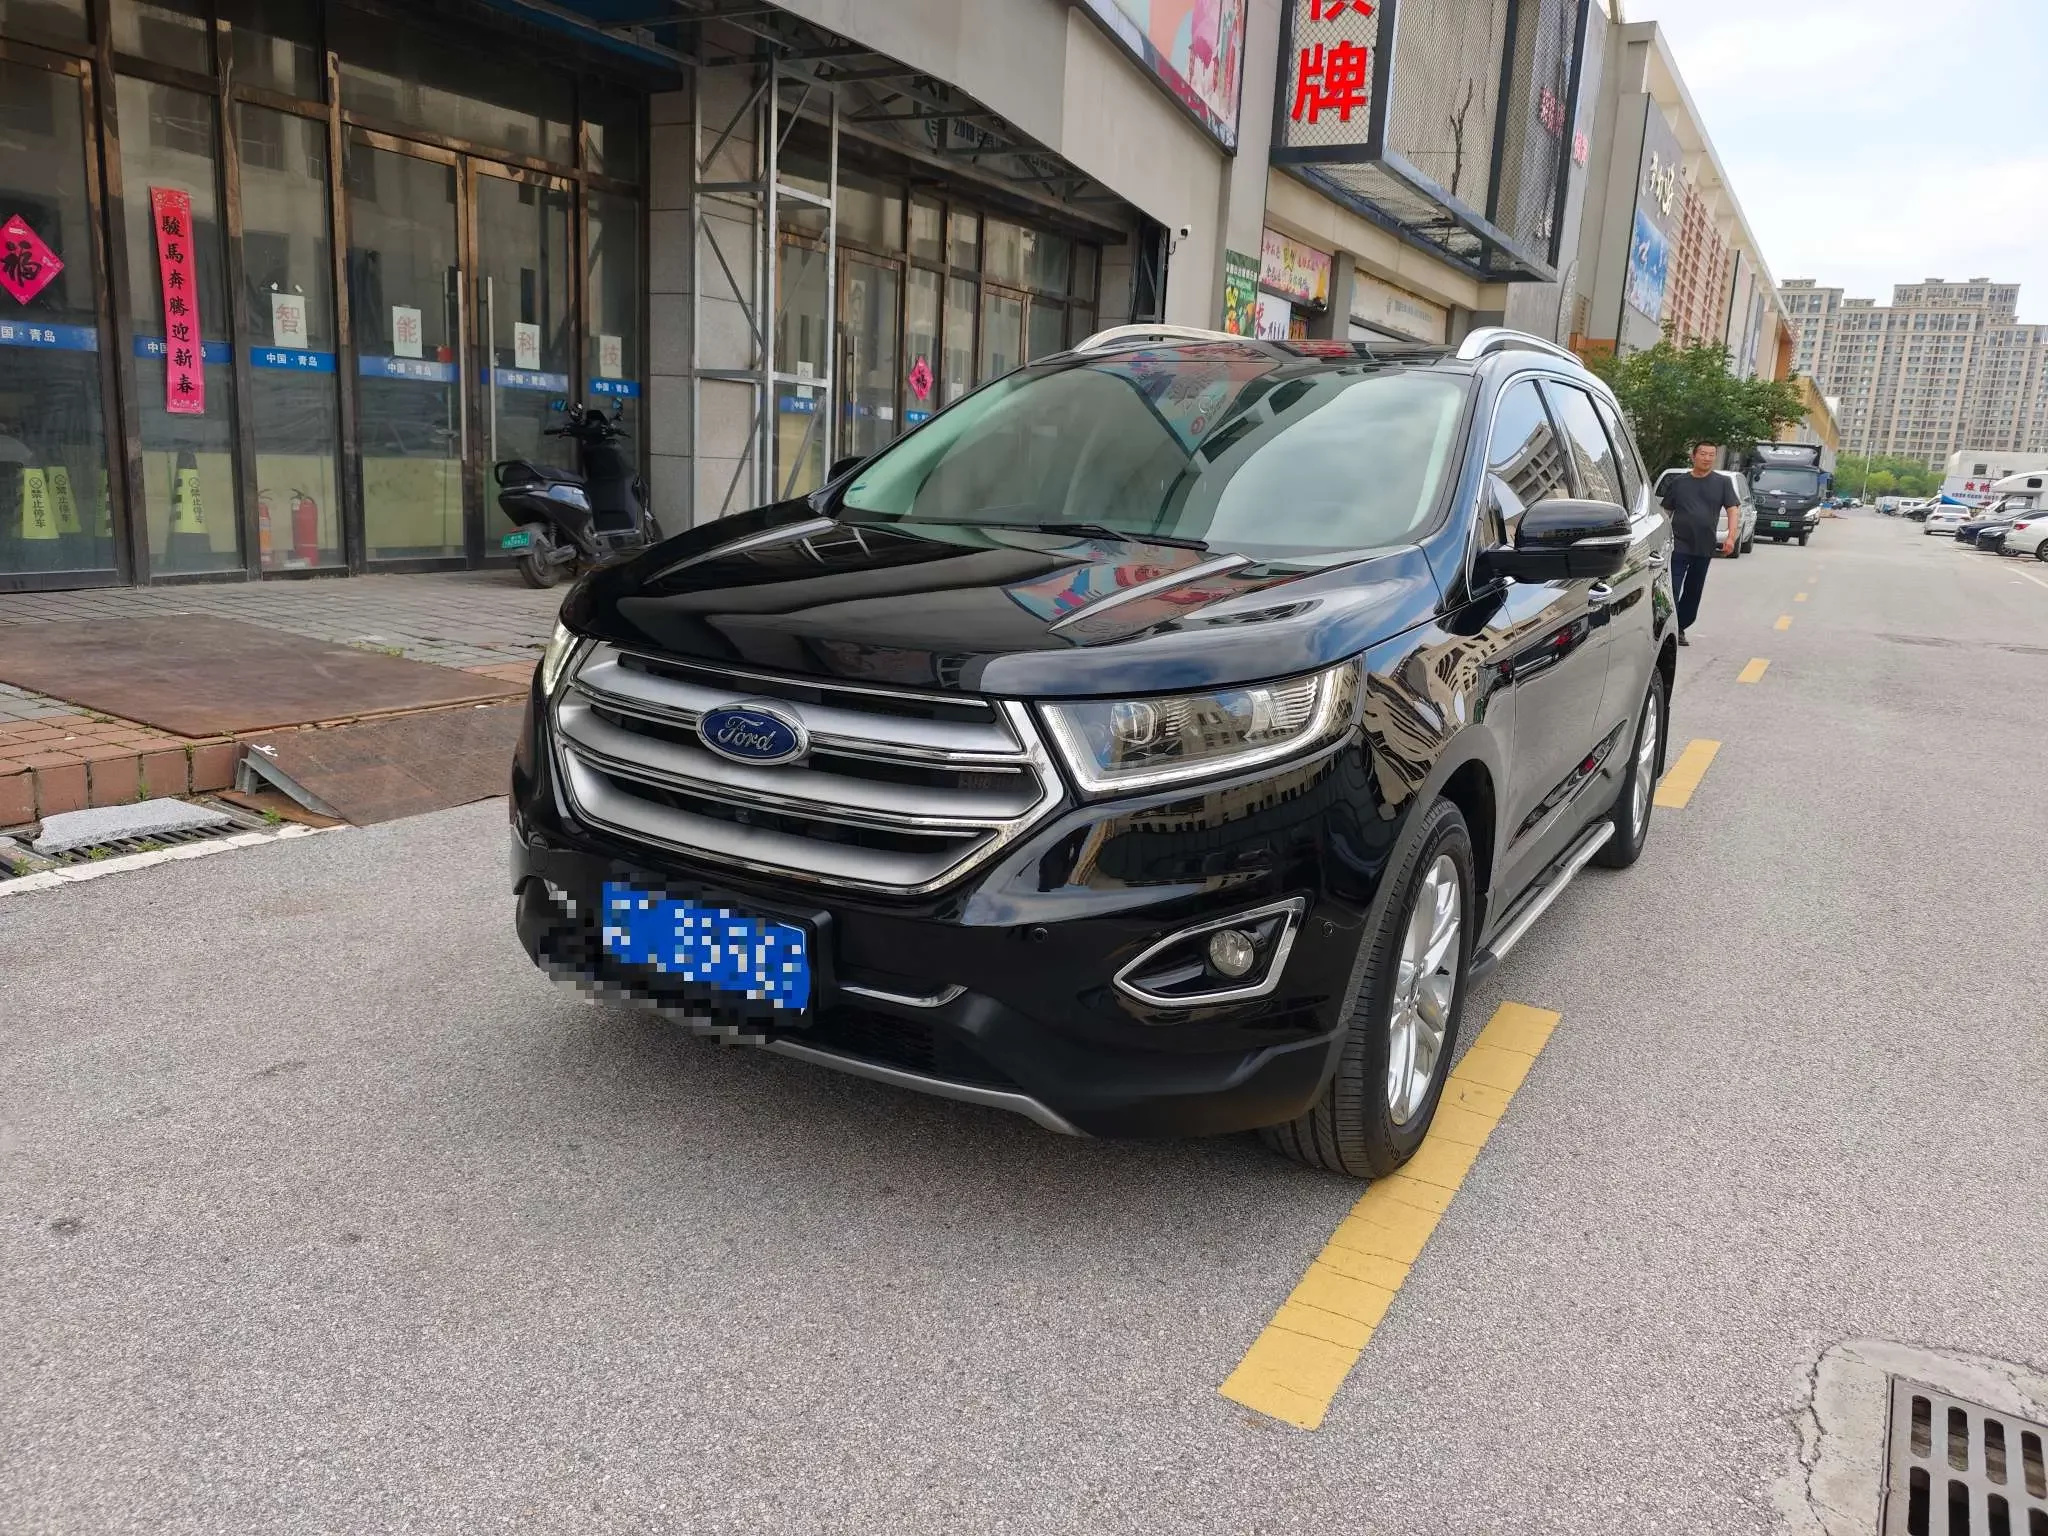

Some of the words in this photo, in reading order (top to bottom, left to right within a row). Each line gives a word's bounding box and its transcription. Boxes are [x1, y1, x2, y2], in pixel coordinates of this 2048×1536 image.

[1291, 0, 1374, 124] 牌
[1, 241, 42, 288] 福
[276, 304, 300, 334] 智
[397, 316, 418, 343] 能
[518, 331, 537, 358] 科
[603, 344, 620, 367] 技
[717, 716, 776, 751] Ford
